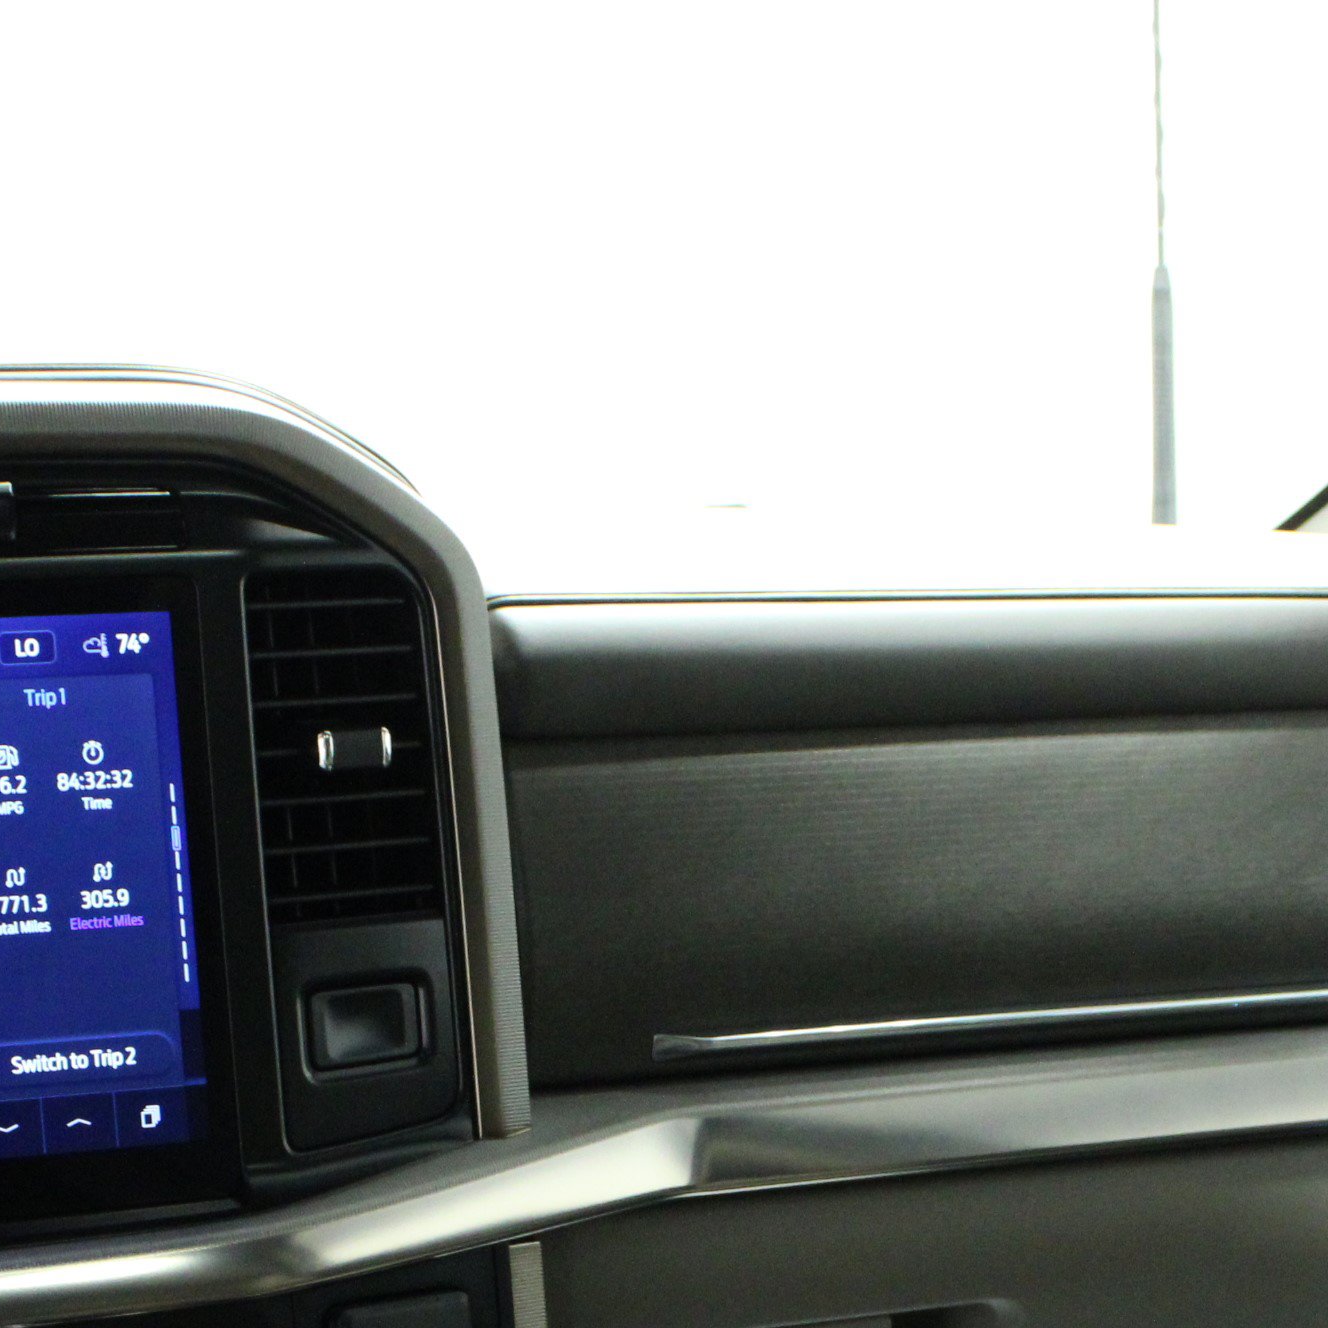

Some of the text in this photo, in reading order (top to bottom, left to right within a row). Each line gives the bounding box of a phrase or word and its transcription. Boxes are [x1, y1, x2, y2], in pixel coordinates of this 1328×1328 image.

[14, 638, 40, 658] LO
[116, 632, 150, 655] 74°
[23, 687, 67, 709] Trip 1
[56, 769, 134, 792] 84:32:32
[82, 796, 113, 811] Time
[81, 888, 130, 909] 305.9
[19, 919, 52, 935] Miles
[69, 914, 145, 931] Electric Miles
[11, 1047, 138, 1075] Switch to Trip 2
